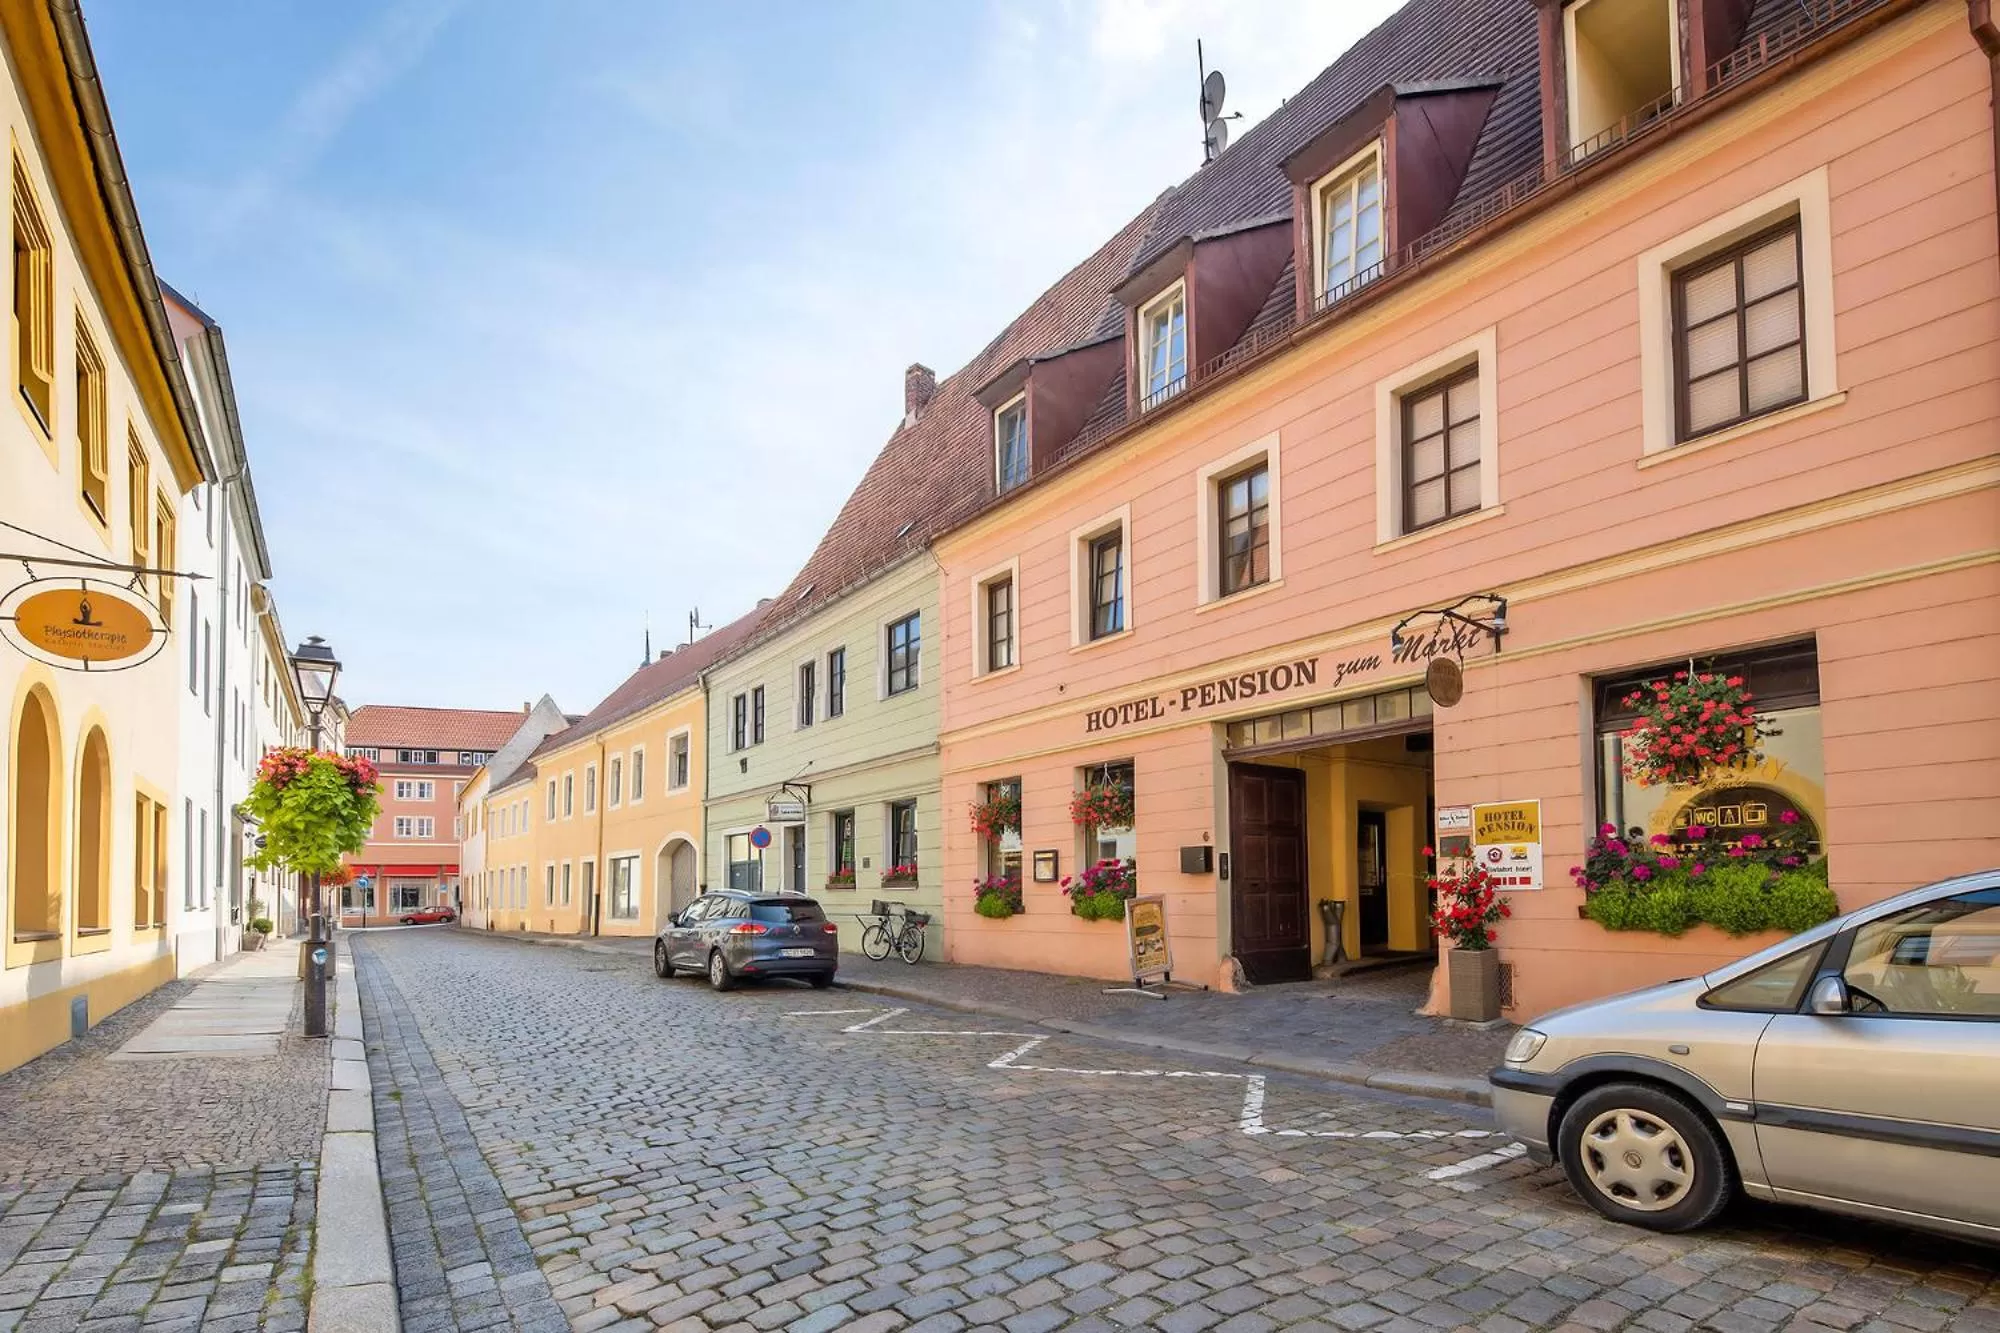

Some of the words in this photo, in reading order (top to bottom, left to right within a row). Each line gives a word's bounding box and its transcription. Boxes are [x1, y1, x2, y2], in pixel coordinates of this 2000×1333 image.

[43, 625, 129, 645] Physiotherapie
[1333, 655, 1382, 688] zum
[1392, 623, 1481, 664] Markt
[1484, 810, 1526, 823] HOTEL
[1695, 811, 1715, 824] WC
[1478, 821, 1536, 837] PENSION
[1202, 831, 1210, 842] 6
